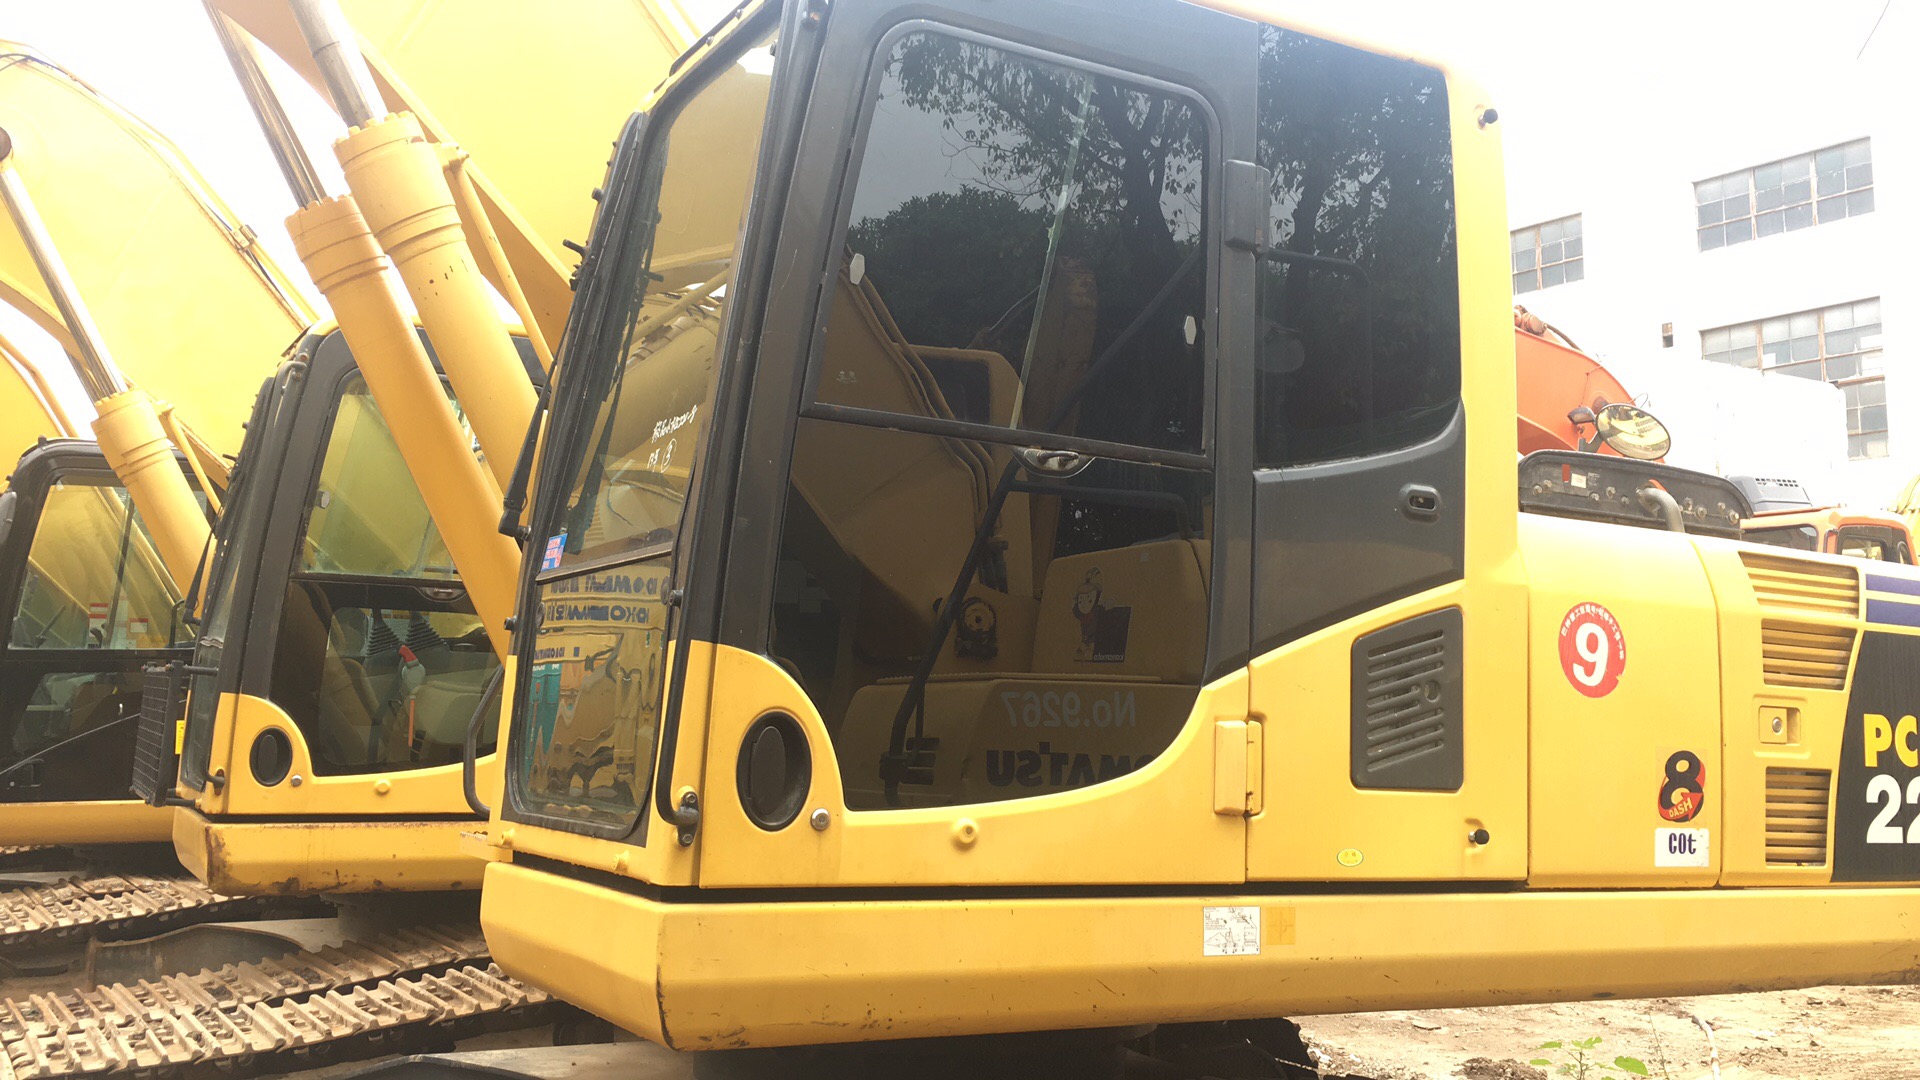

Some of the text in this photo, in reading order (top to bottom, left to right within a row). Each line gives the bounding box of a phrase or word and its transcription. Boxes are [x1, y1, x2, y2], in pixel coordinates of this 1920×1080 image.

[1573, 622, 1609, 687] 9
[1863, 713, 1920, 768] PC
[1660, 750, 1703, 823] 8
[1668, 797, 1693, 818] DASH
